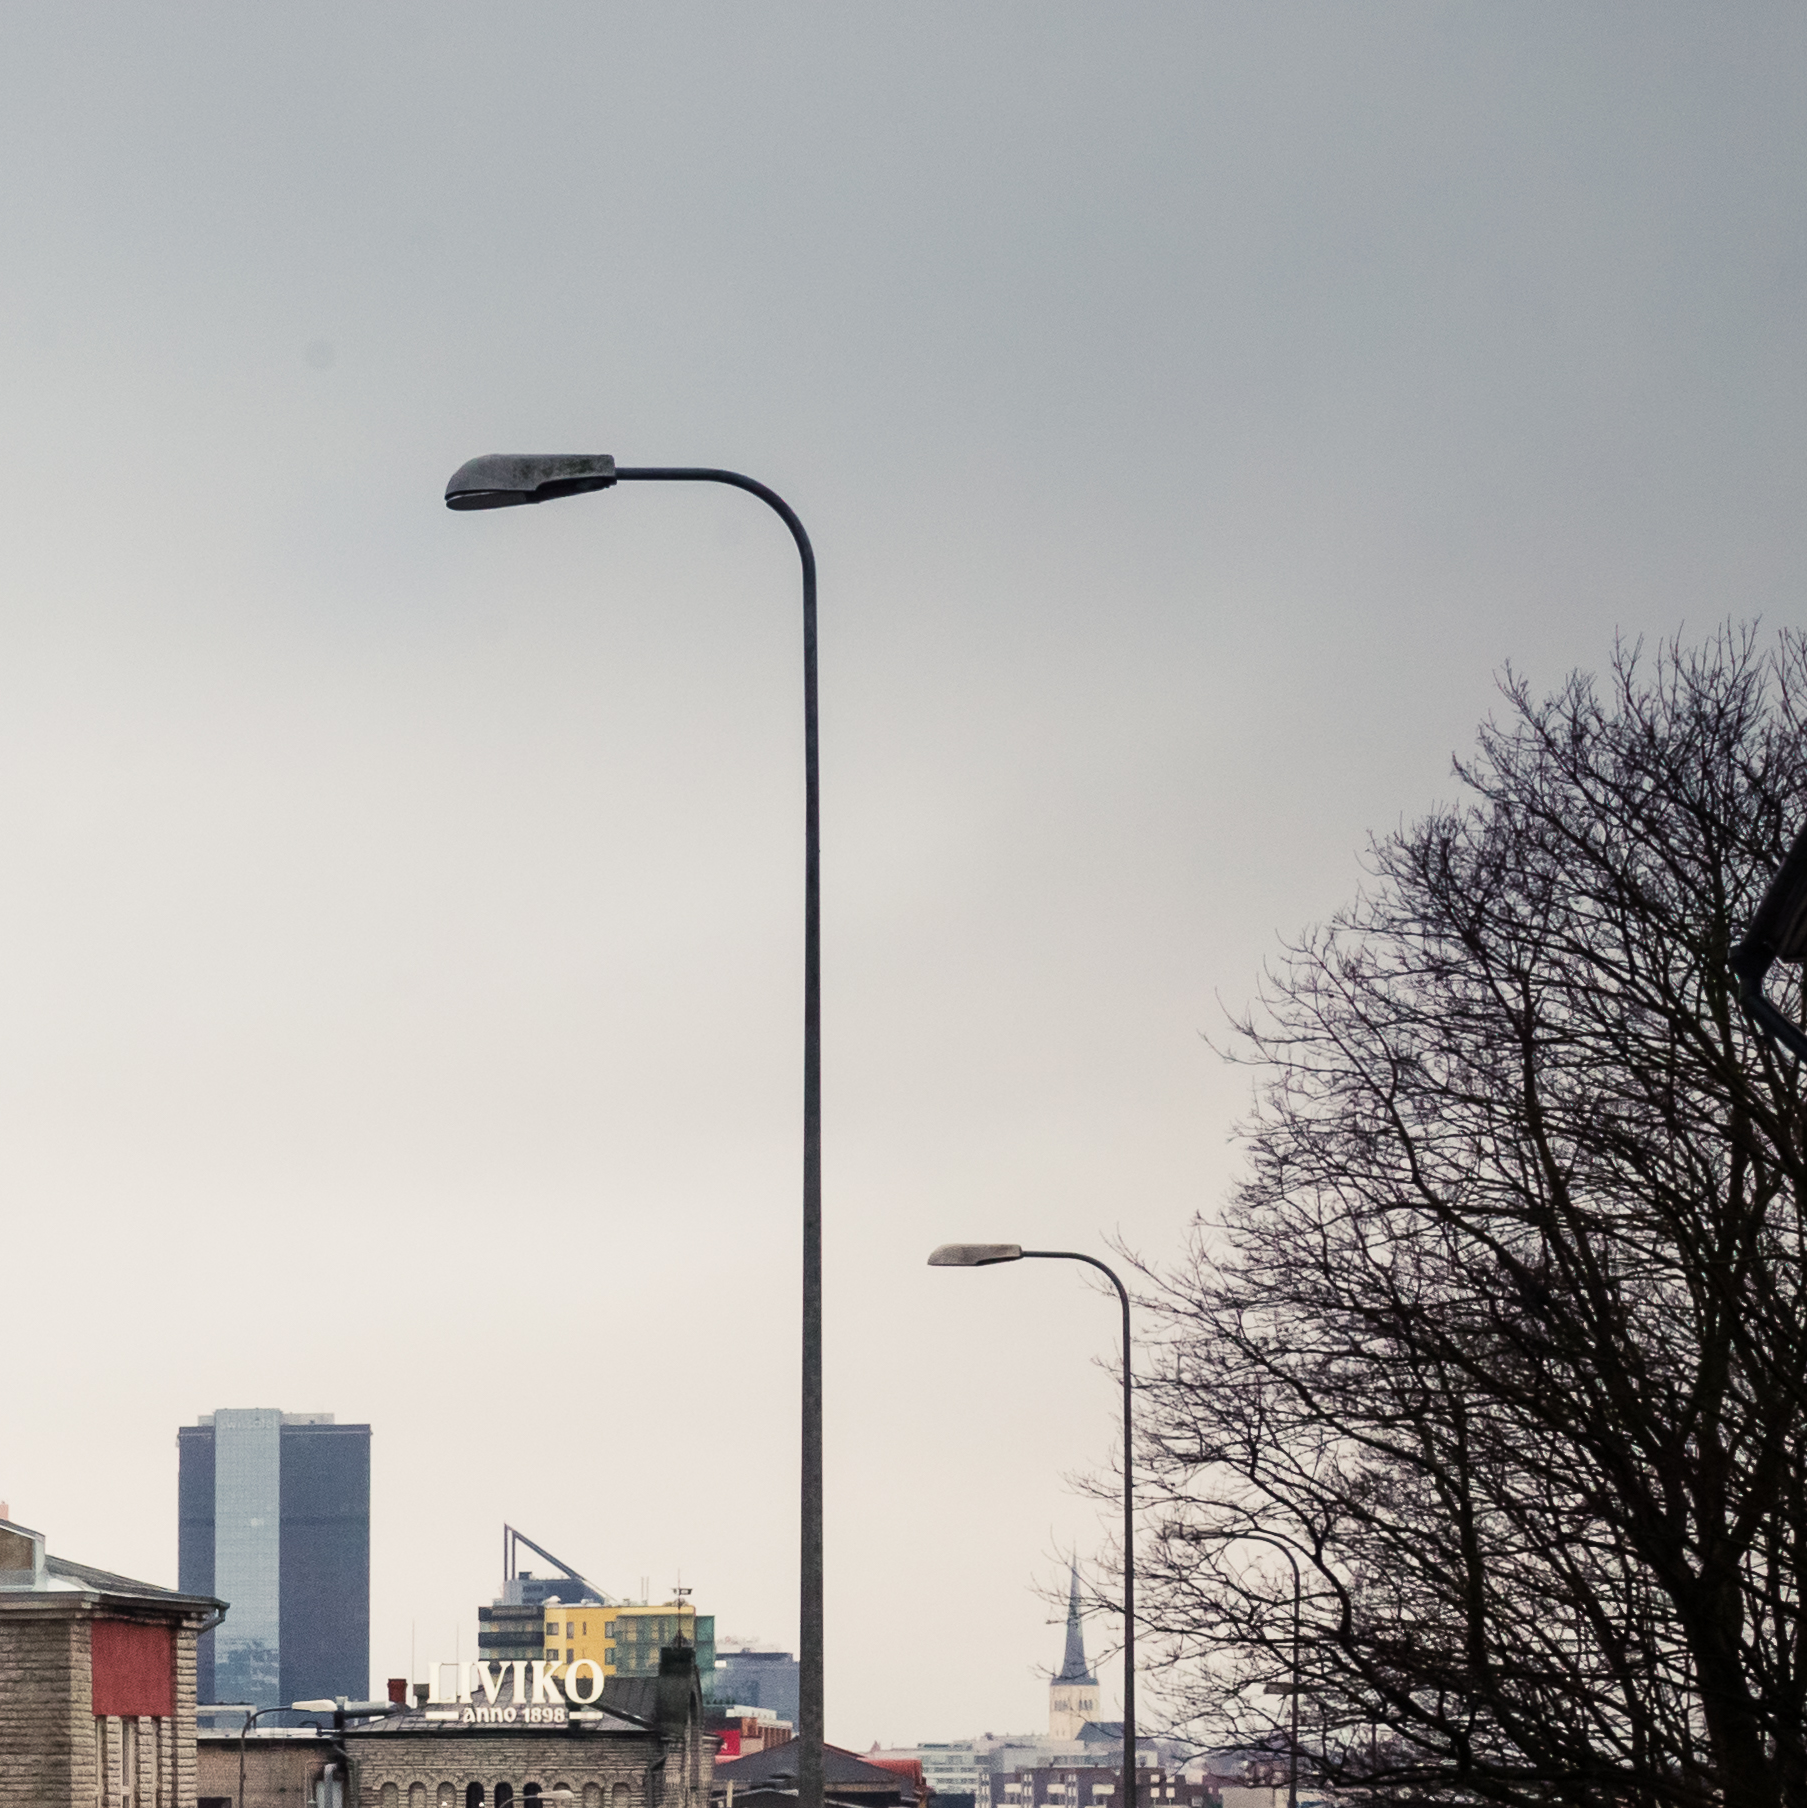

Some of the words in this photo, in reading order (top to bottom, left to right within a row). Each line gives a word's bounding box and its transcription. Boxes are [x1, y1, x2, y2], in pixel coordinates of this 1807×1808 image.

[427, 1659, 605, 1704] LIVIKO
[462, 1706, 517, 1723] anno
[519, 1707, 566, 1723] 1898
